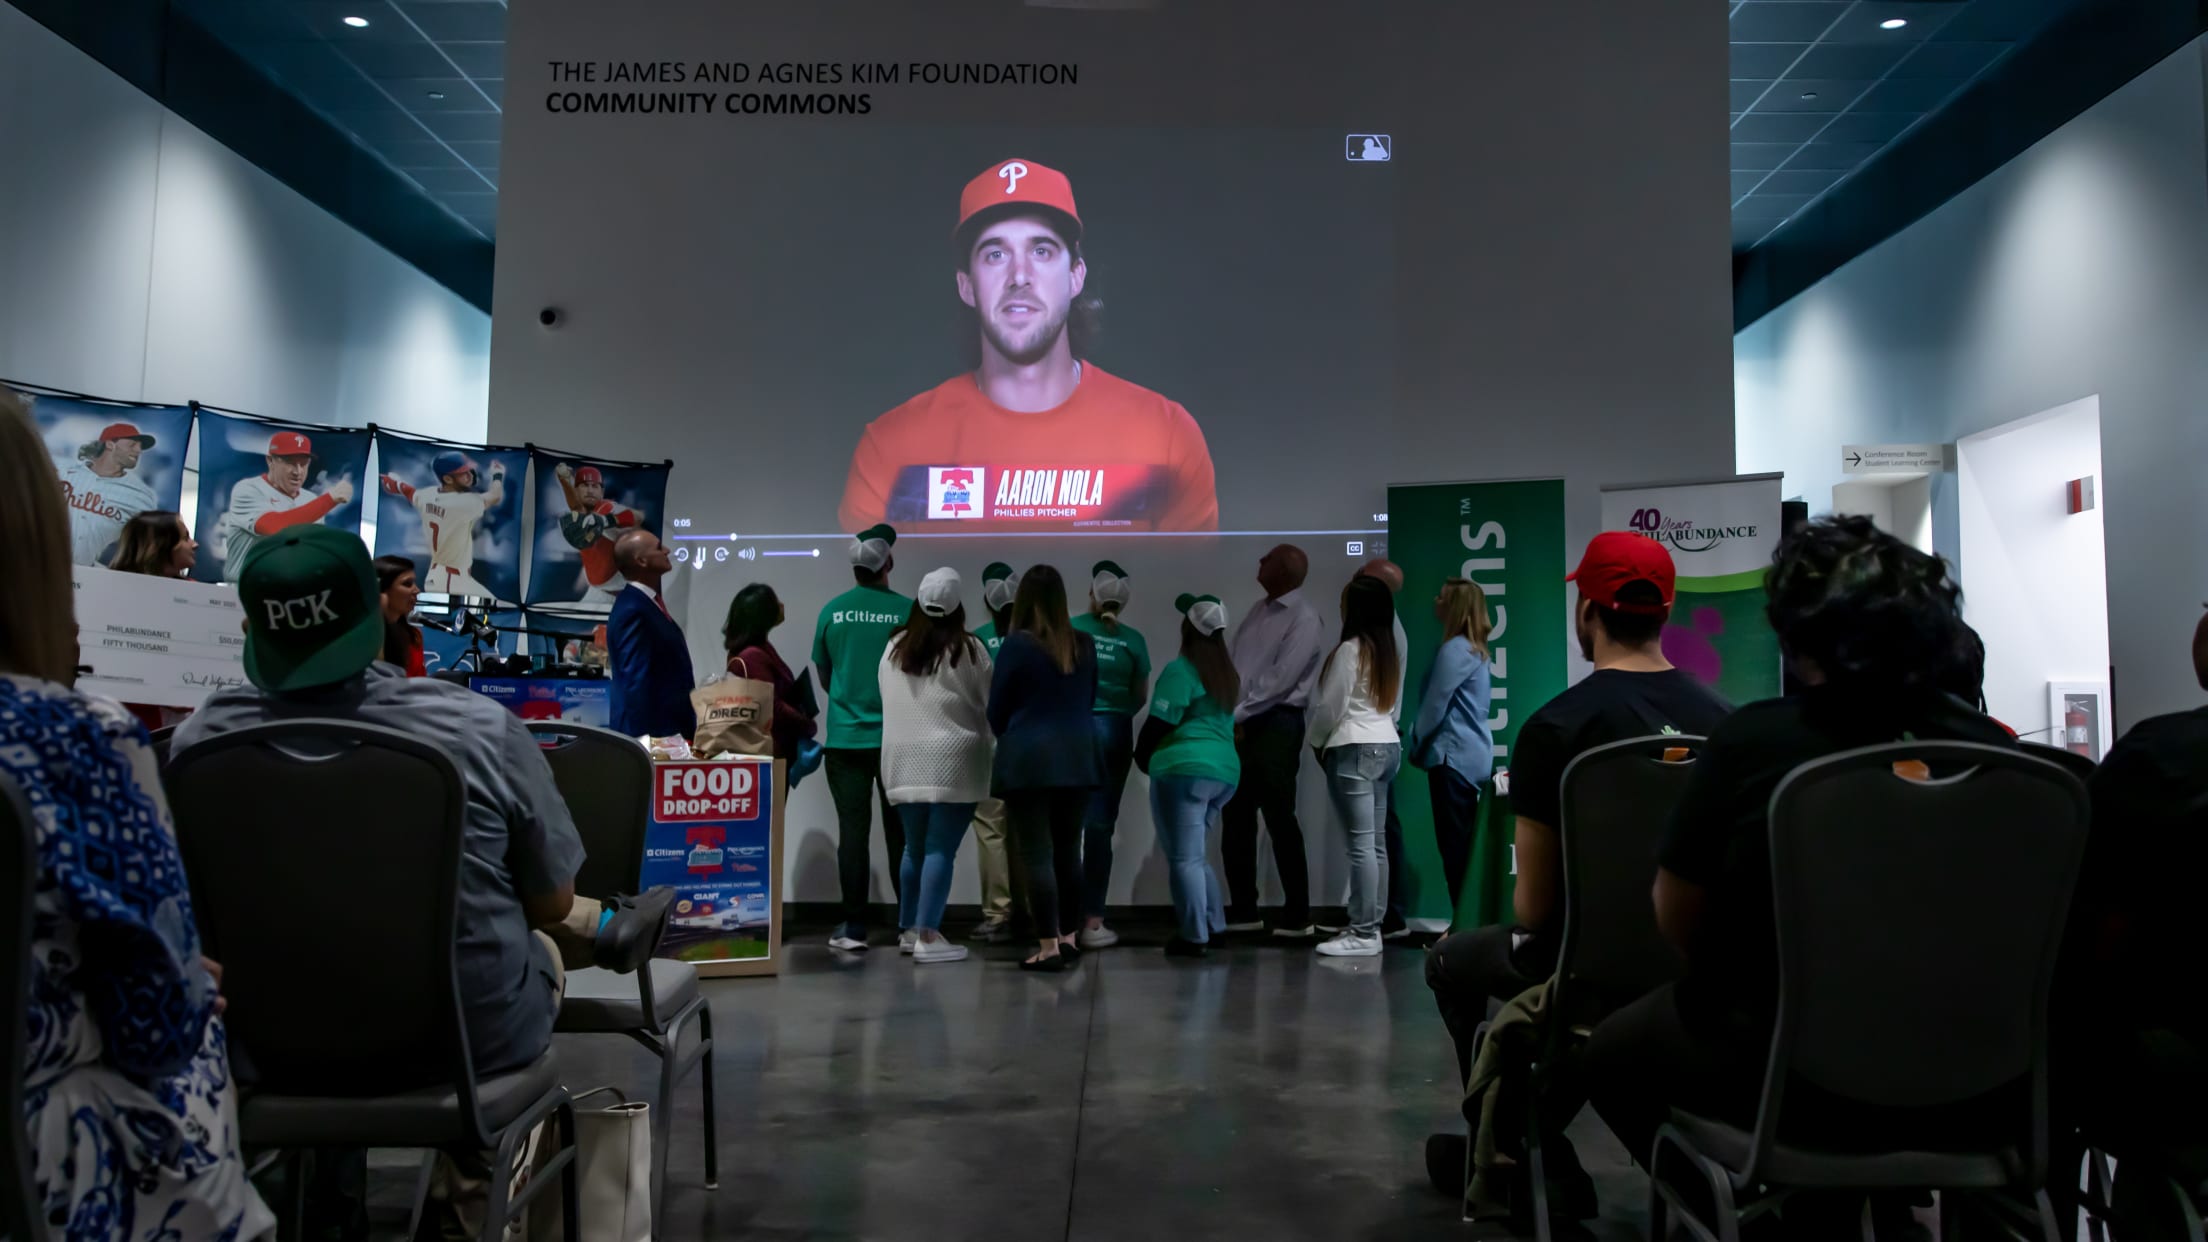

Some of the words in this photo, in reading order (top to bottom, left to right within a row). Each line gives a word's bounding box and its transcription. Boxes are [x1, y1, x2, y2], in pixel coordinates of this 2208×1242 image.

[548, 61, 596, 83] THE
[603, 61, 686, 83] JAMES
[693, 62, 750, 84] AND
[757, 62, 843, 84] AGNES
[851, 63, 899, 84] KIM
[908, 63, 1078, 84] FOUNDATION
[546, 92, 717, 114] COMMUNITY
[725, 93, 871, 114] COMMONS
[1864, 450, 1905, 458] Conference
[1906, 450, 1928, 458] Room
[994, 469, 1057, 506] AARON
[1057, 469, 1104, 506] NOLA
[60, 480, 122, 522] Phillies
[993, 508, 1035, 517] PHILLIES
[1037, 508, 1077, 517] PITCHER
[673, 518, 691, 527] 0:05
[1629, 508, 1661, 531] 40
[1661, 516, 1693, 535] Years
[429, 521, 439, 552] 7
[1631, 526, 1757, 543] ILABUNDANCE
[263, 589, 339, 630] PCK
[845, 610, 899, 624] Citizens
[106, 624, 172, 639] PHILABUNDANCE
[103, 638, 124, 648] FIFTY
[126, 640, 168, 653] THOUSAND
[488, 685, 515, 693] Citizens
[709, 707, 757, 720] DIRECT
[663, 767, 753, 797] FOOD
[663, 798, 752, 815] DROP-OFF
[654, 848, 685, 857] Citizens
[693, 892, 719, 901] GIANT
